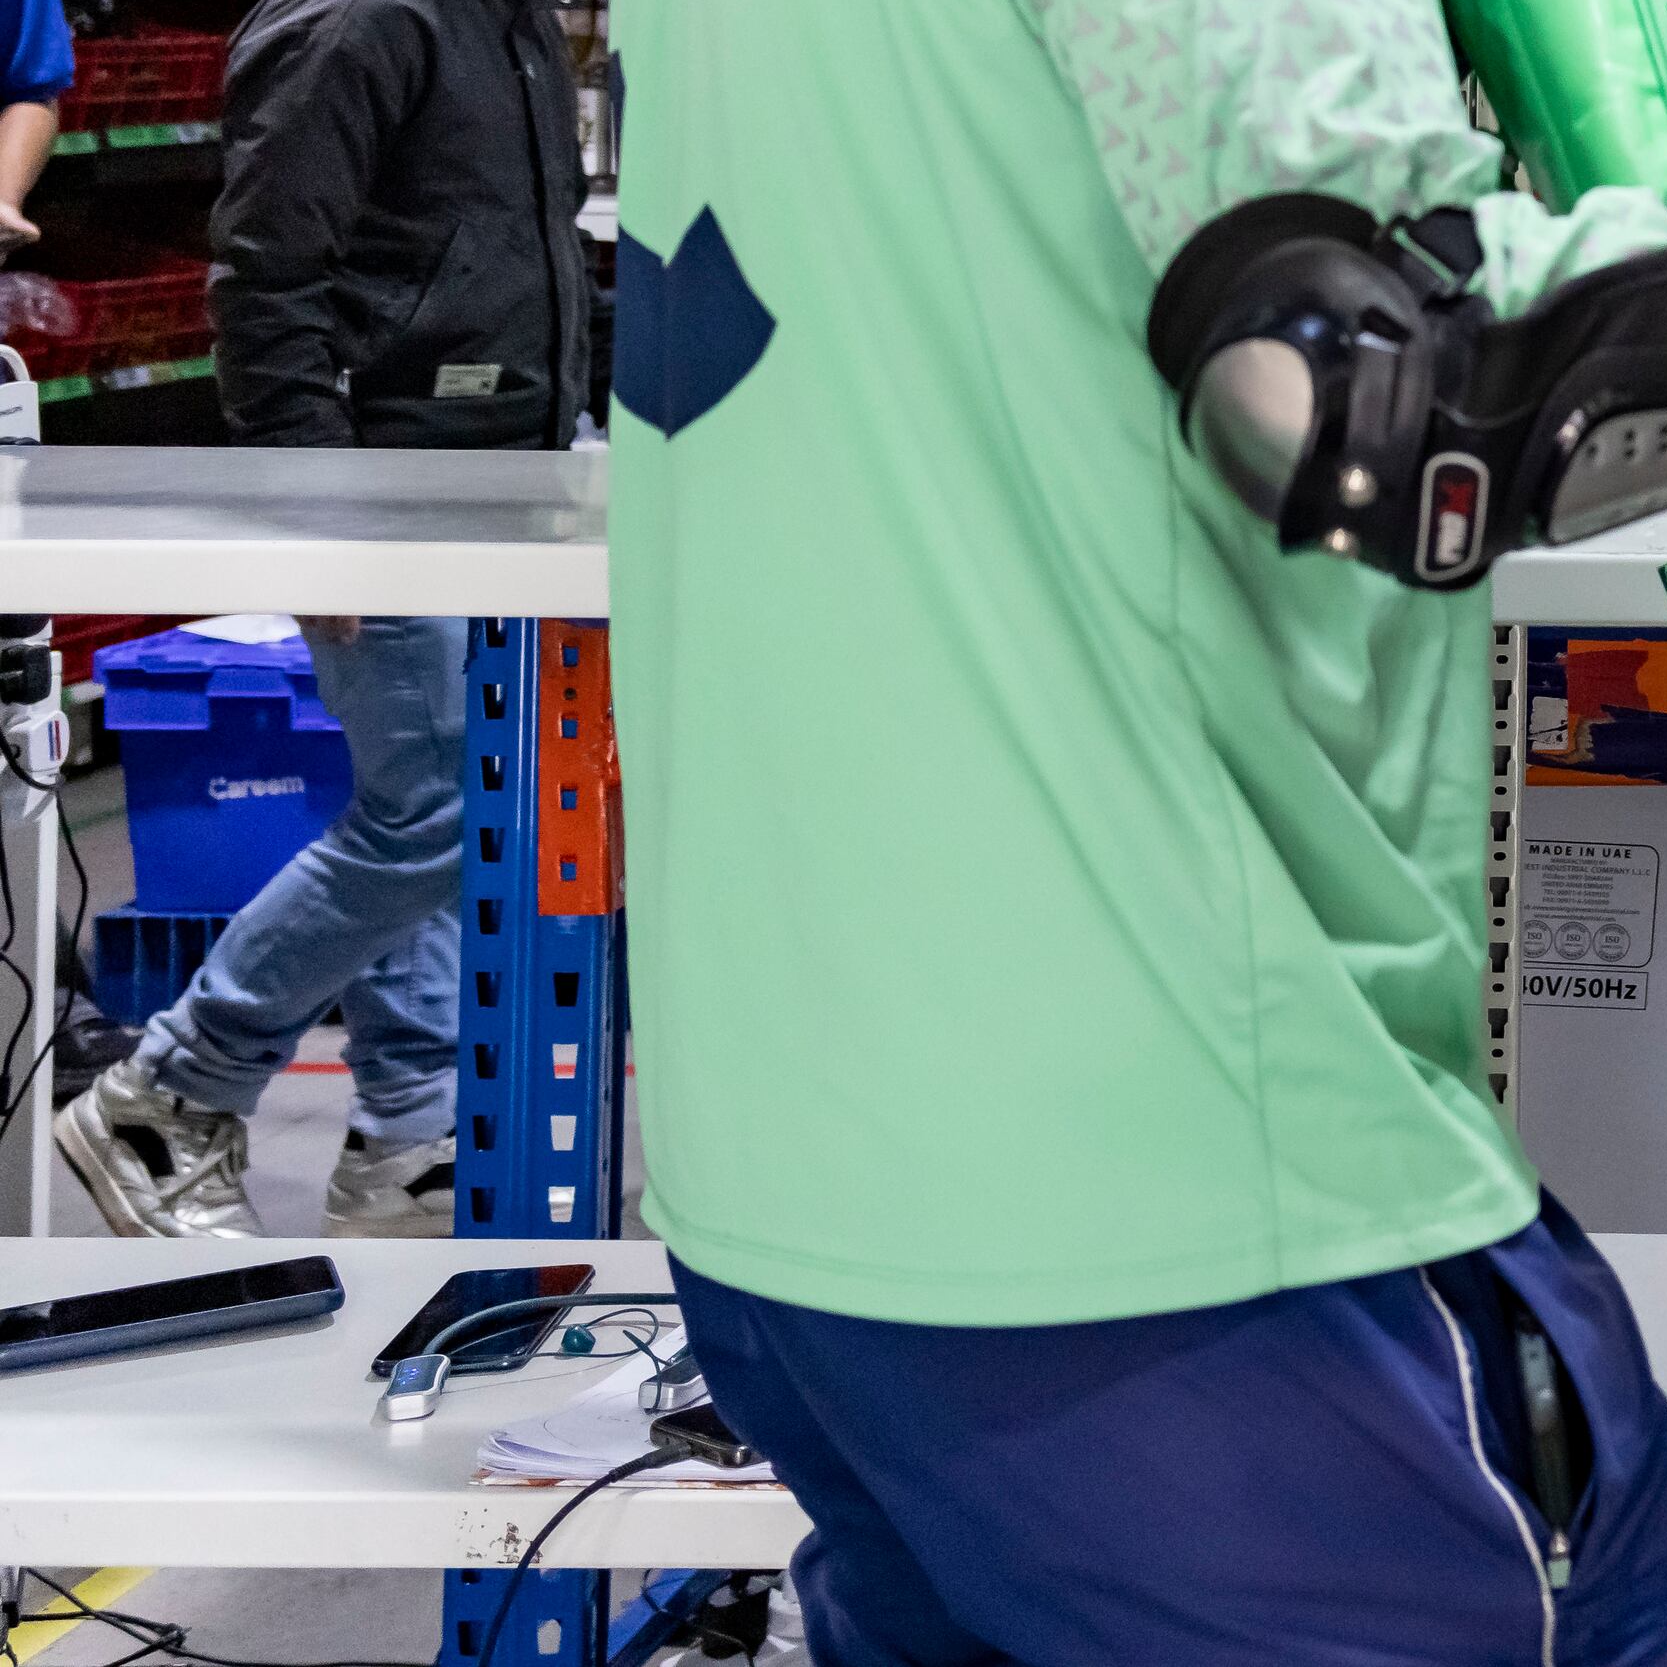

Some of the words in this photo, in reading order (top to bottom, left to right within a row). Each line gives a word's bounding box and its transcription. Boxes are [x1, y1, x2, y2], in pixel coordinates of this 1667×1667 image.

[1529, 844, 1572, 856] MADE
[1580, 846, 1595, 857] IN
[1602, 848, 1632, 859] UAE
[1528, 932, 1542, 940] ISO
[1567, 934, 1581, 942] ISO
